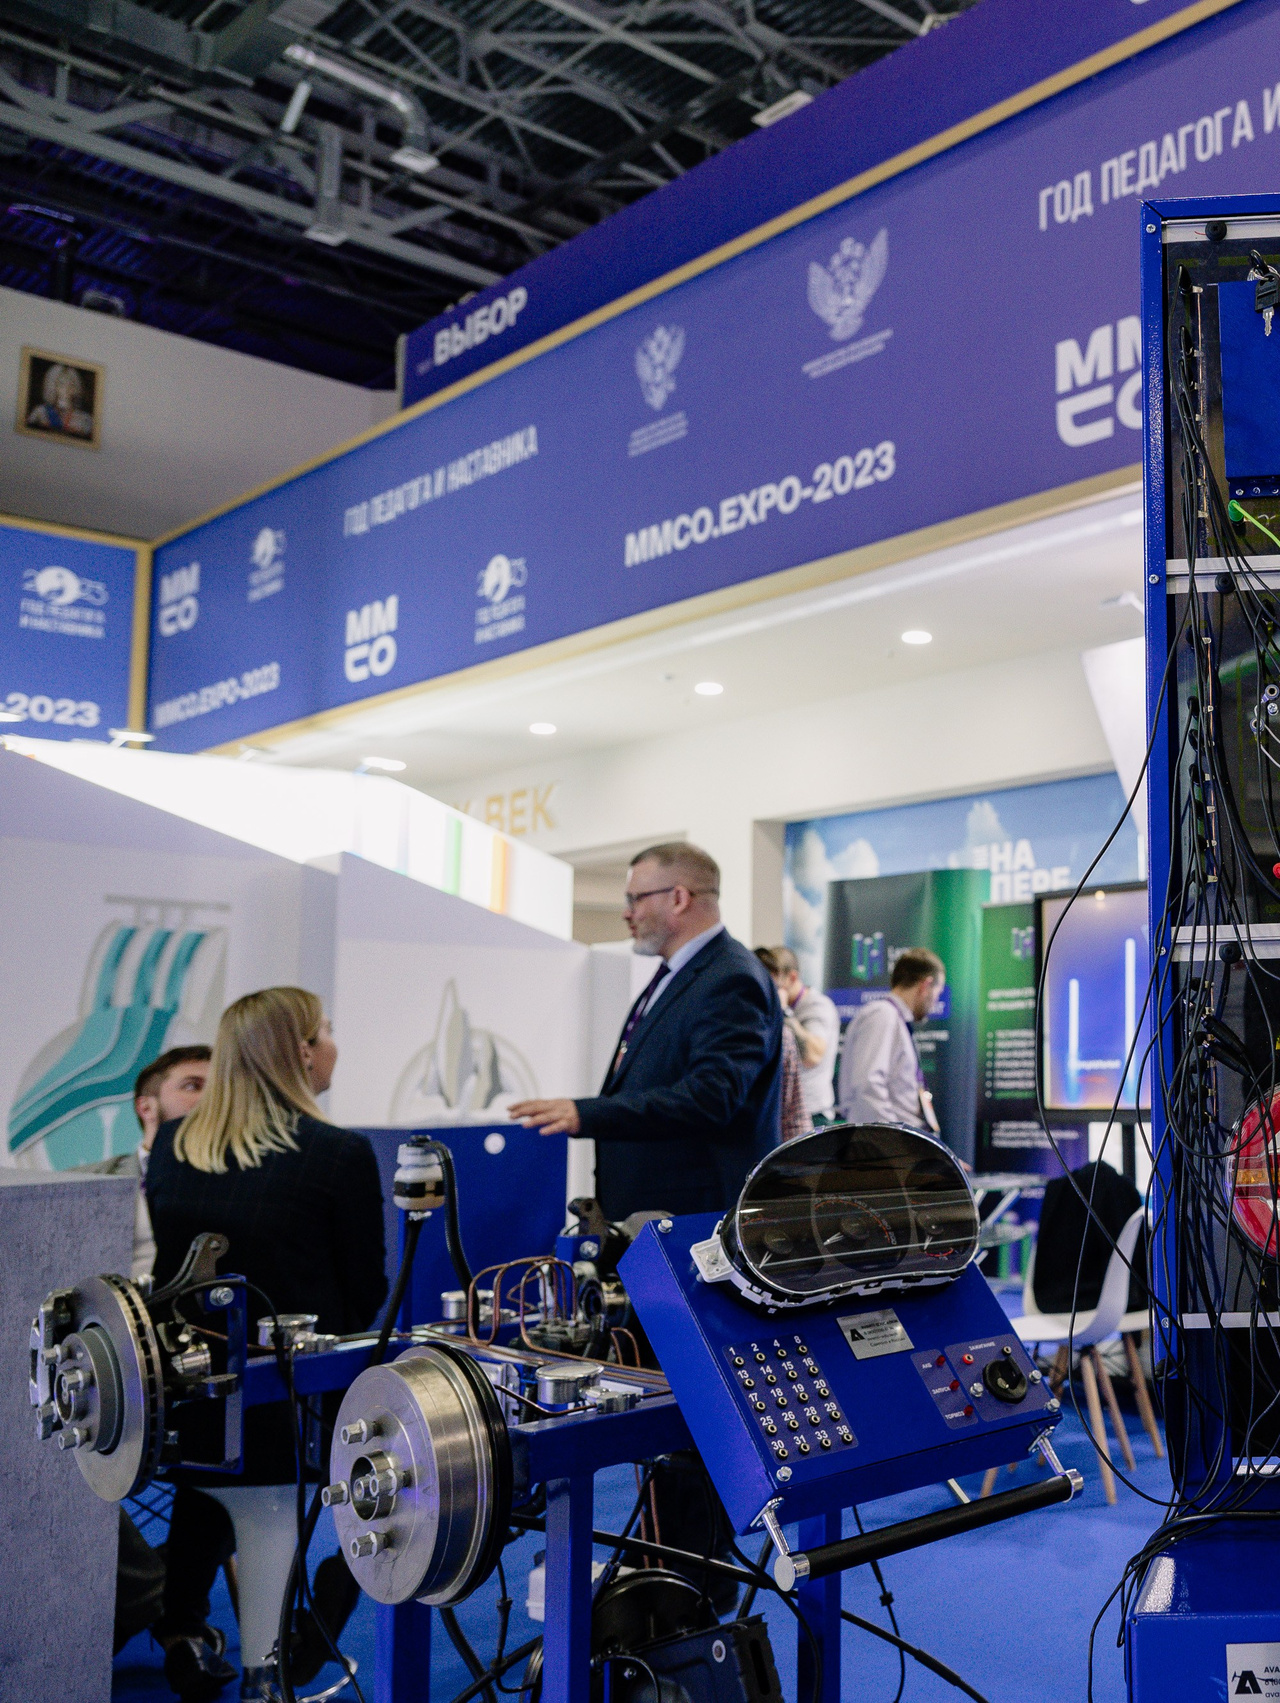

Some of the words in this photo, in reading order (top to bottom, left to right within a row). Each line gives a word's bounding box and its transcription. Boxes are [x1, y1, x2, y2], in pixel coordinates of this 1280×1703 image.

[1038, 170, 1092, 231] ГОД
[1100, 100, 1255, 204] ПЕДАГОГА
[434, 286, 528, 366] ВЫБОР
[624, 440, 897, 568] MMCO.EXPO-2023
[345, 593, 399, 647] MM
[343, 634, 398, 683] CO
[990, 839, 1036, 873] НА
[729, 1347, 736, 1356] 1
[751, 1343, 759, 1352] 2
[773, 1339, 781, 1347] 4
[794, 1335, 802, 1344] 8
[737, 1369, 749, 1379] 13
[760, 1365, 773, 1375] 14
[781, 1361, 794, 1371] 15
[802, 1357, 815, 1367] 16
[748, 1392, 759, 1402] 17
[770, 1387, 784, 1397] 18
[792, 1383, 805, 1393] 19
[813, 1379, 827, 1389] 20
[760, 1415, 774, 1426] 25
[781, 1411, 796, 1421] 26
[803, 1406, 817, 1416] 28
[824, 1402, 837, 1412] 29
[771, 1440, 785, 1450] 30
[793, 1435, 806, 1445] 31
[814, 1430, 828, 1440] 33
[836, 1425, 850, 1435] 38
